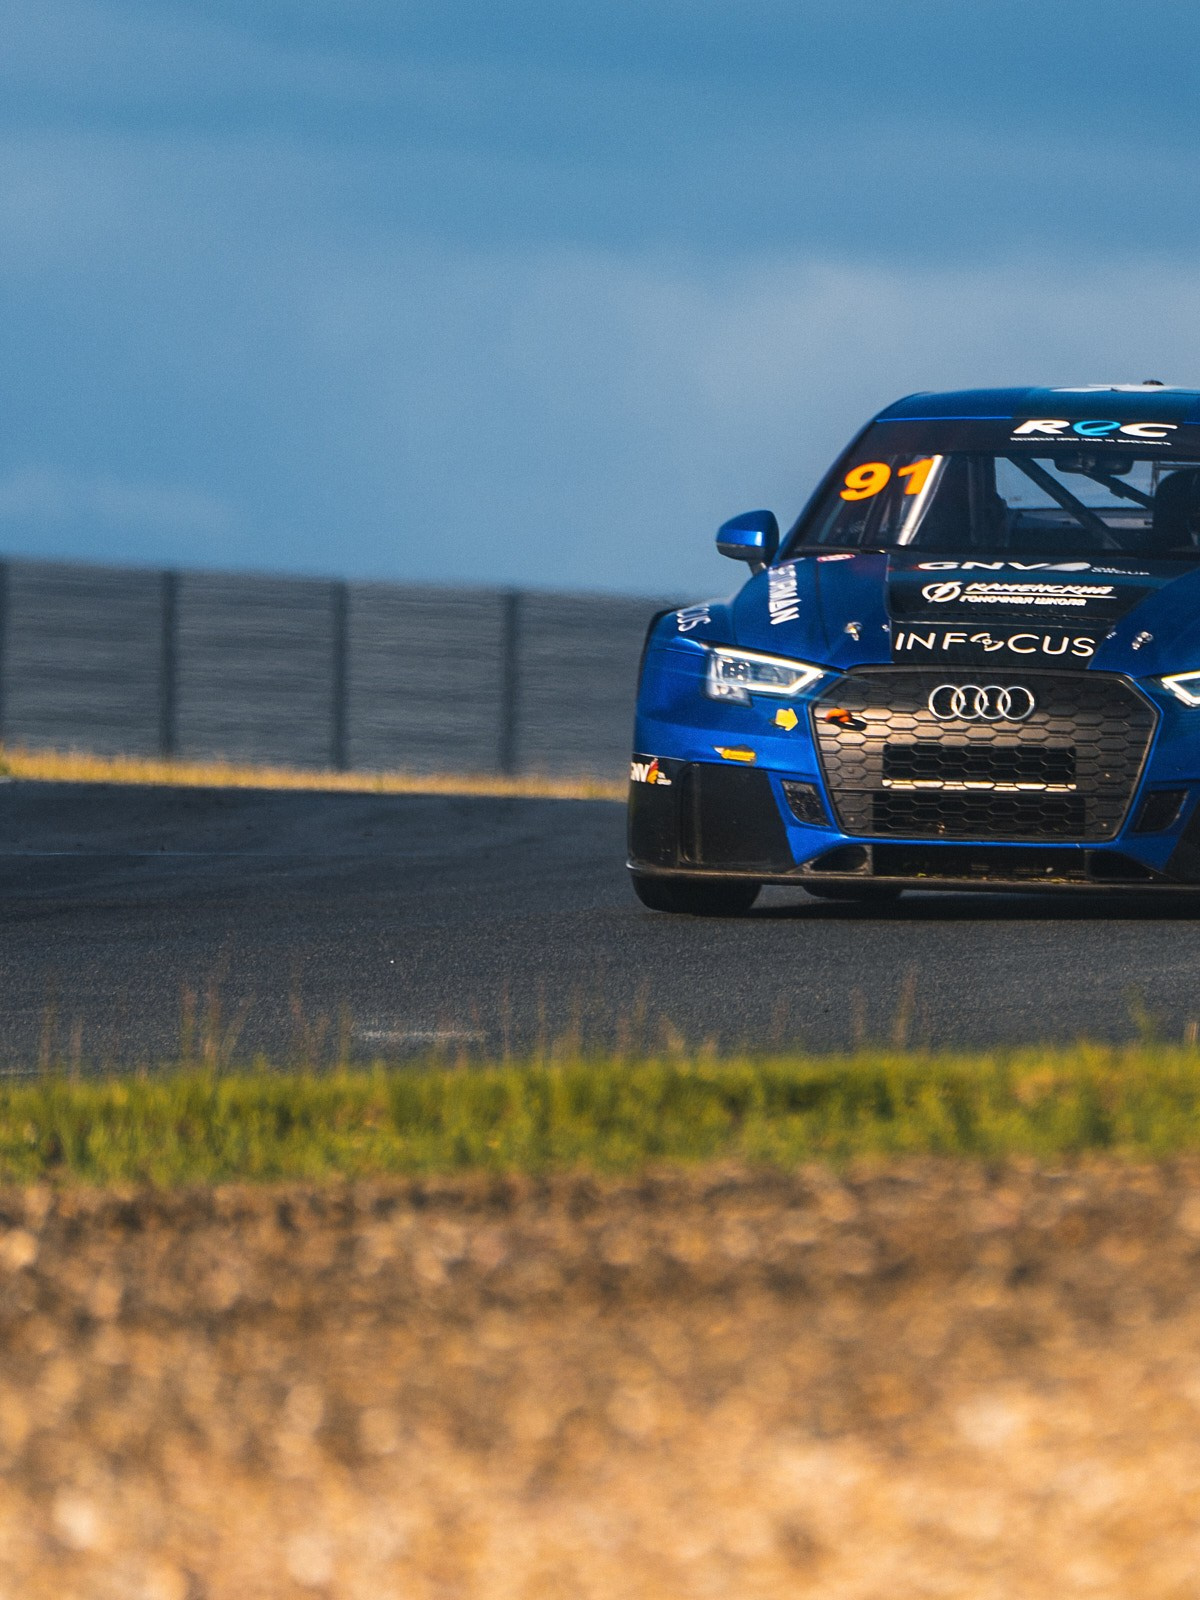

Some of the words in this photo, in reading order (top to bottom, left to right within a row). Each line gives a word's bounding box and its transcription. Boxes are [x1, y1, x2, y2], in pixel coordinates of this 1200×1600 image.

[840, 457, 935, 501] 91
[916, 561, 1054, 571] GNV
[630, 762, 650, 783] NV
